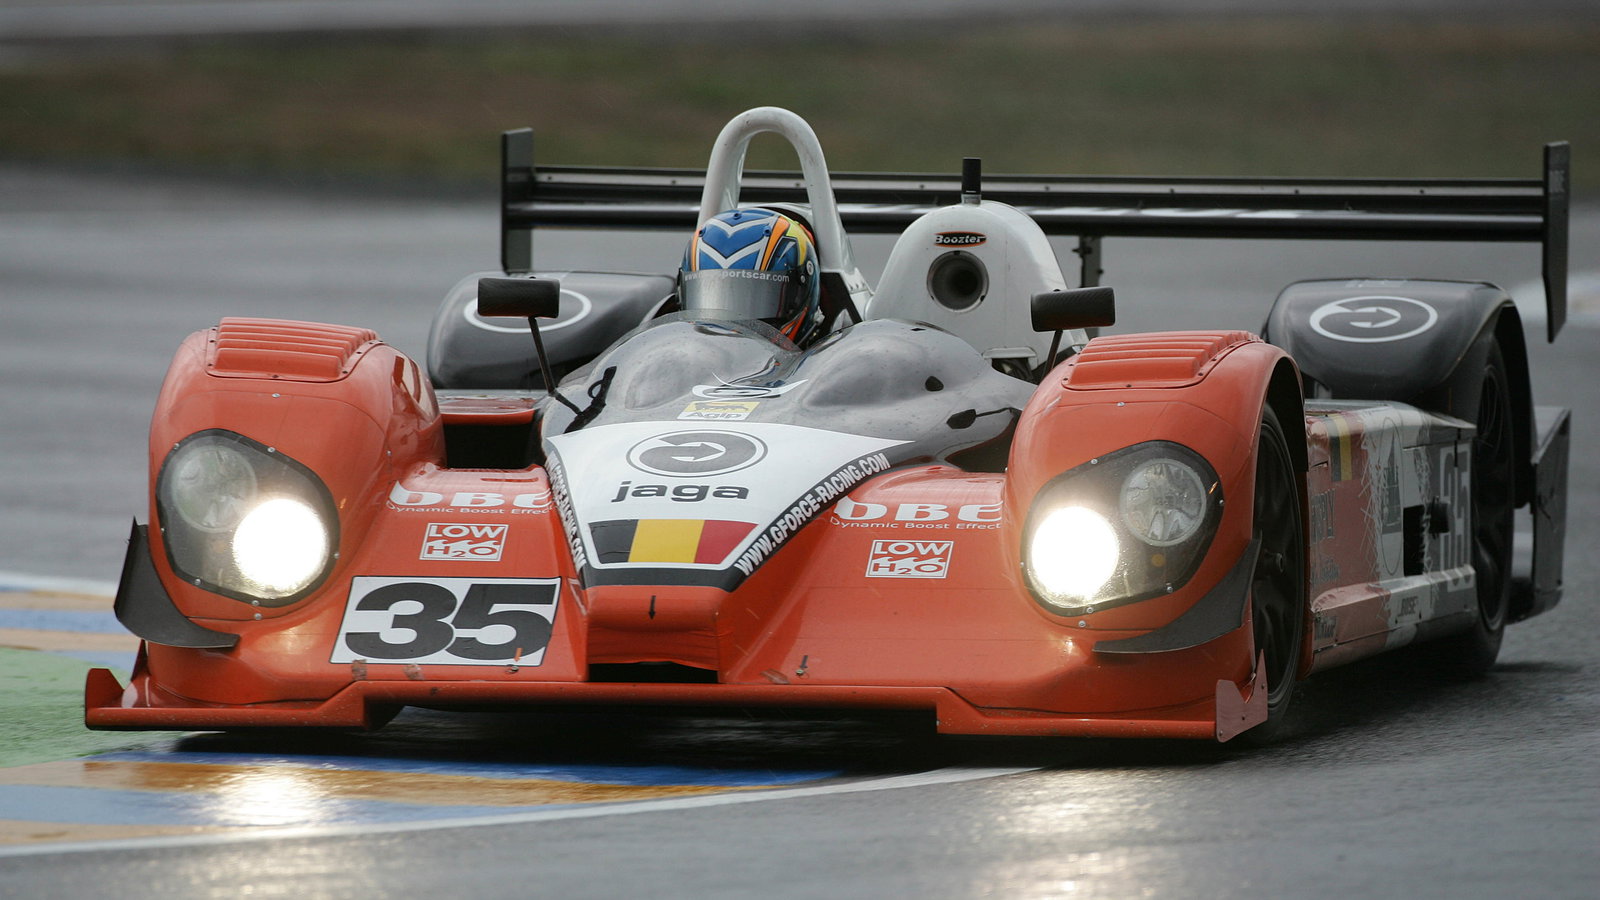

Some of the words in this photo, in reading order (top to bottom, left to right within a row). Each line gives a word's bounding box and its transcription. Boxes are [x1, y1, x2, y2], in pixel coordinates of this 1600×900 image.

[935, 235, 986, 244] Boozter
[611, 480, 750, 502] jaga
[386, 501, 454, 514] Dynamic
[734, 452, 891, 577] WWW.GFORCE-RACING.COM
[830, 517, 899, 528] Dynamic
[428, 526, 504, 538] LOW
[874, 542, 950, 555] LOW
[345, 582, 557, 660] 35
